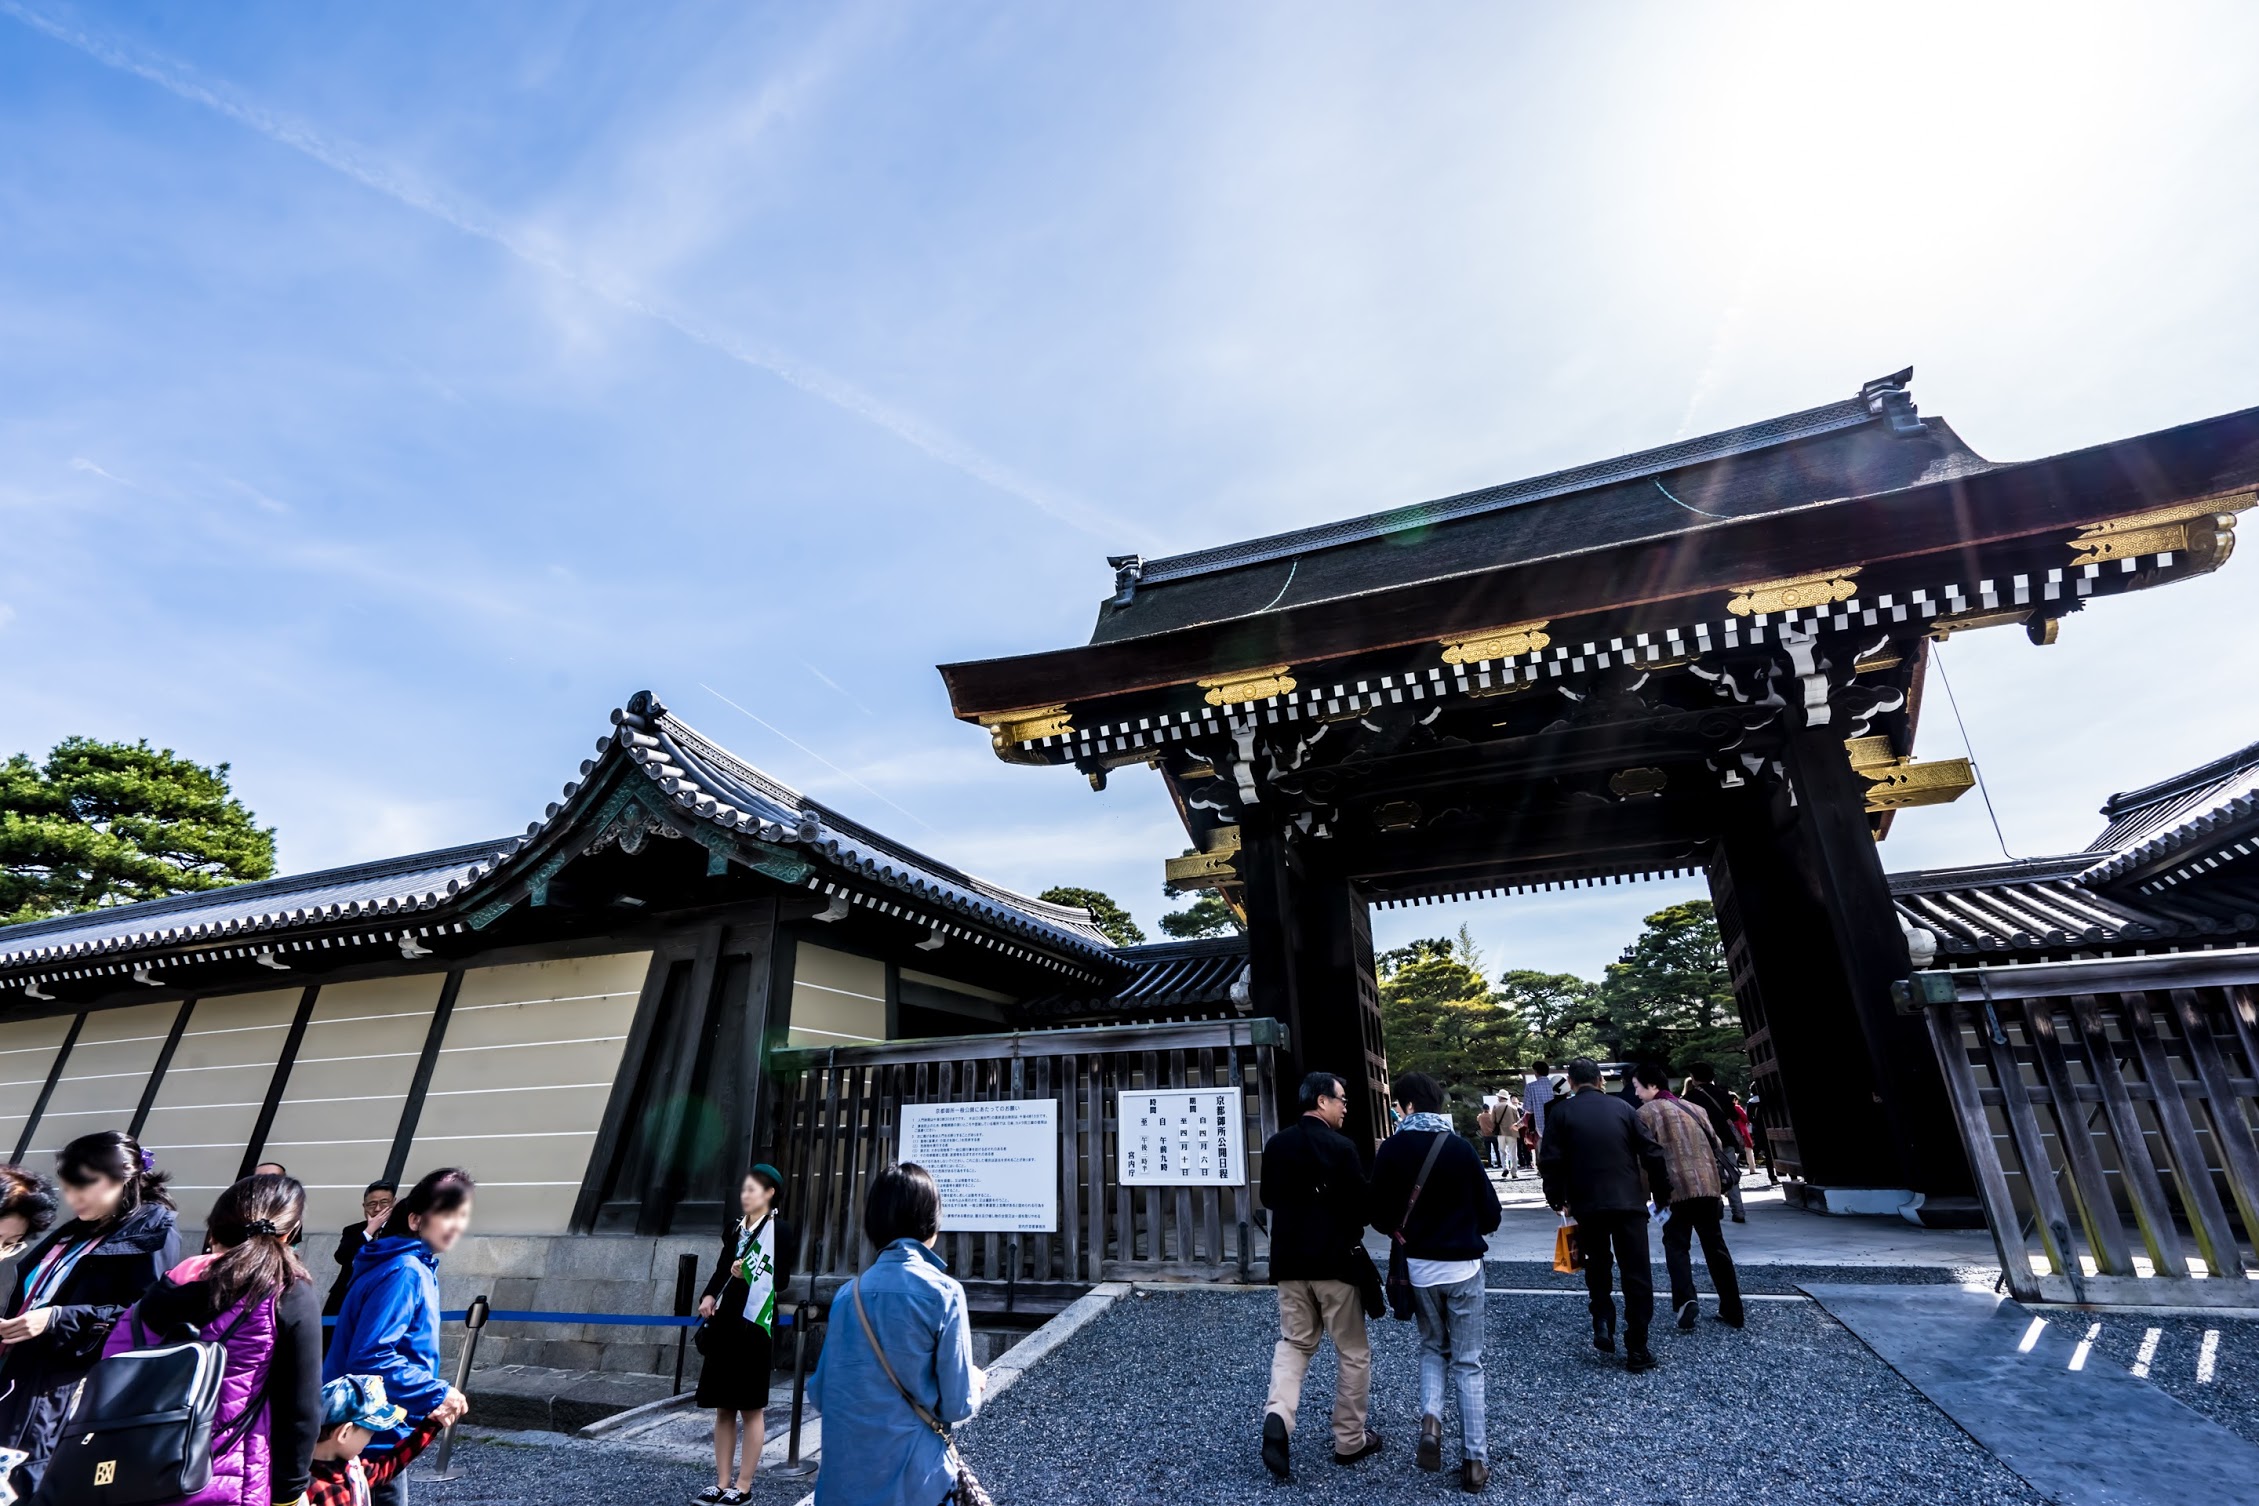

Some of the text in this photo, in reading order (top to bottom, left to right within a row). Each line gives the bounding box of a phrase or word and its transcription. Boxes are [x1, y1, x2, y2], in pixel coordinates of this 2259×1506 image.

[1149, 1098, 1157, 1114] 時間
[1189, 1097, 1197, 1113] 期間
[1216, 1095, 1229, 1179] 京都御所公開日程
[1128, 1151, 1136, 1178] 宮内庁
[1160, 1136, 1168, 1172] 午前九時
